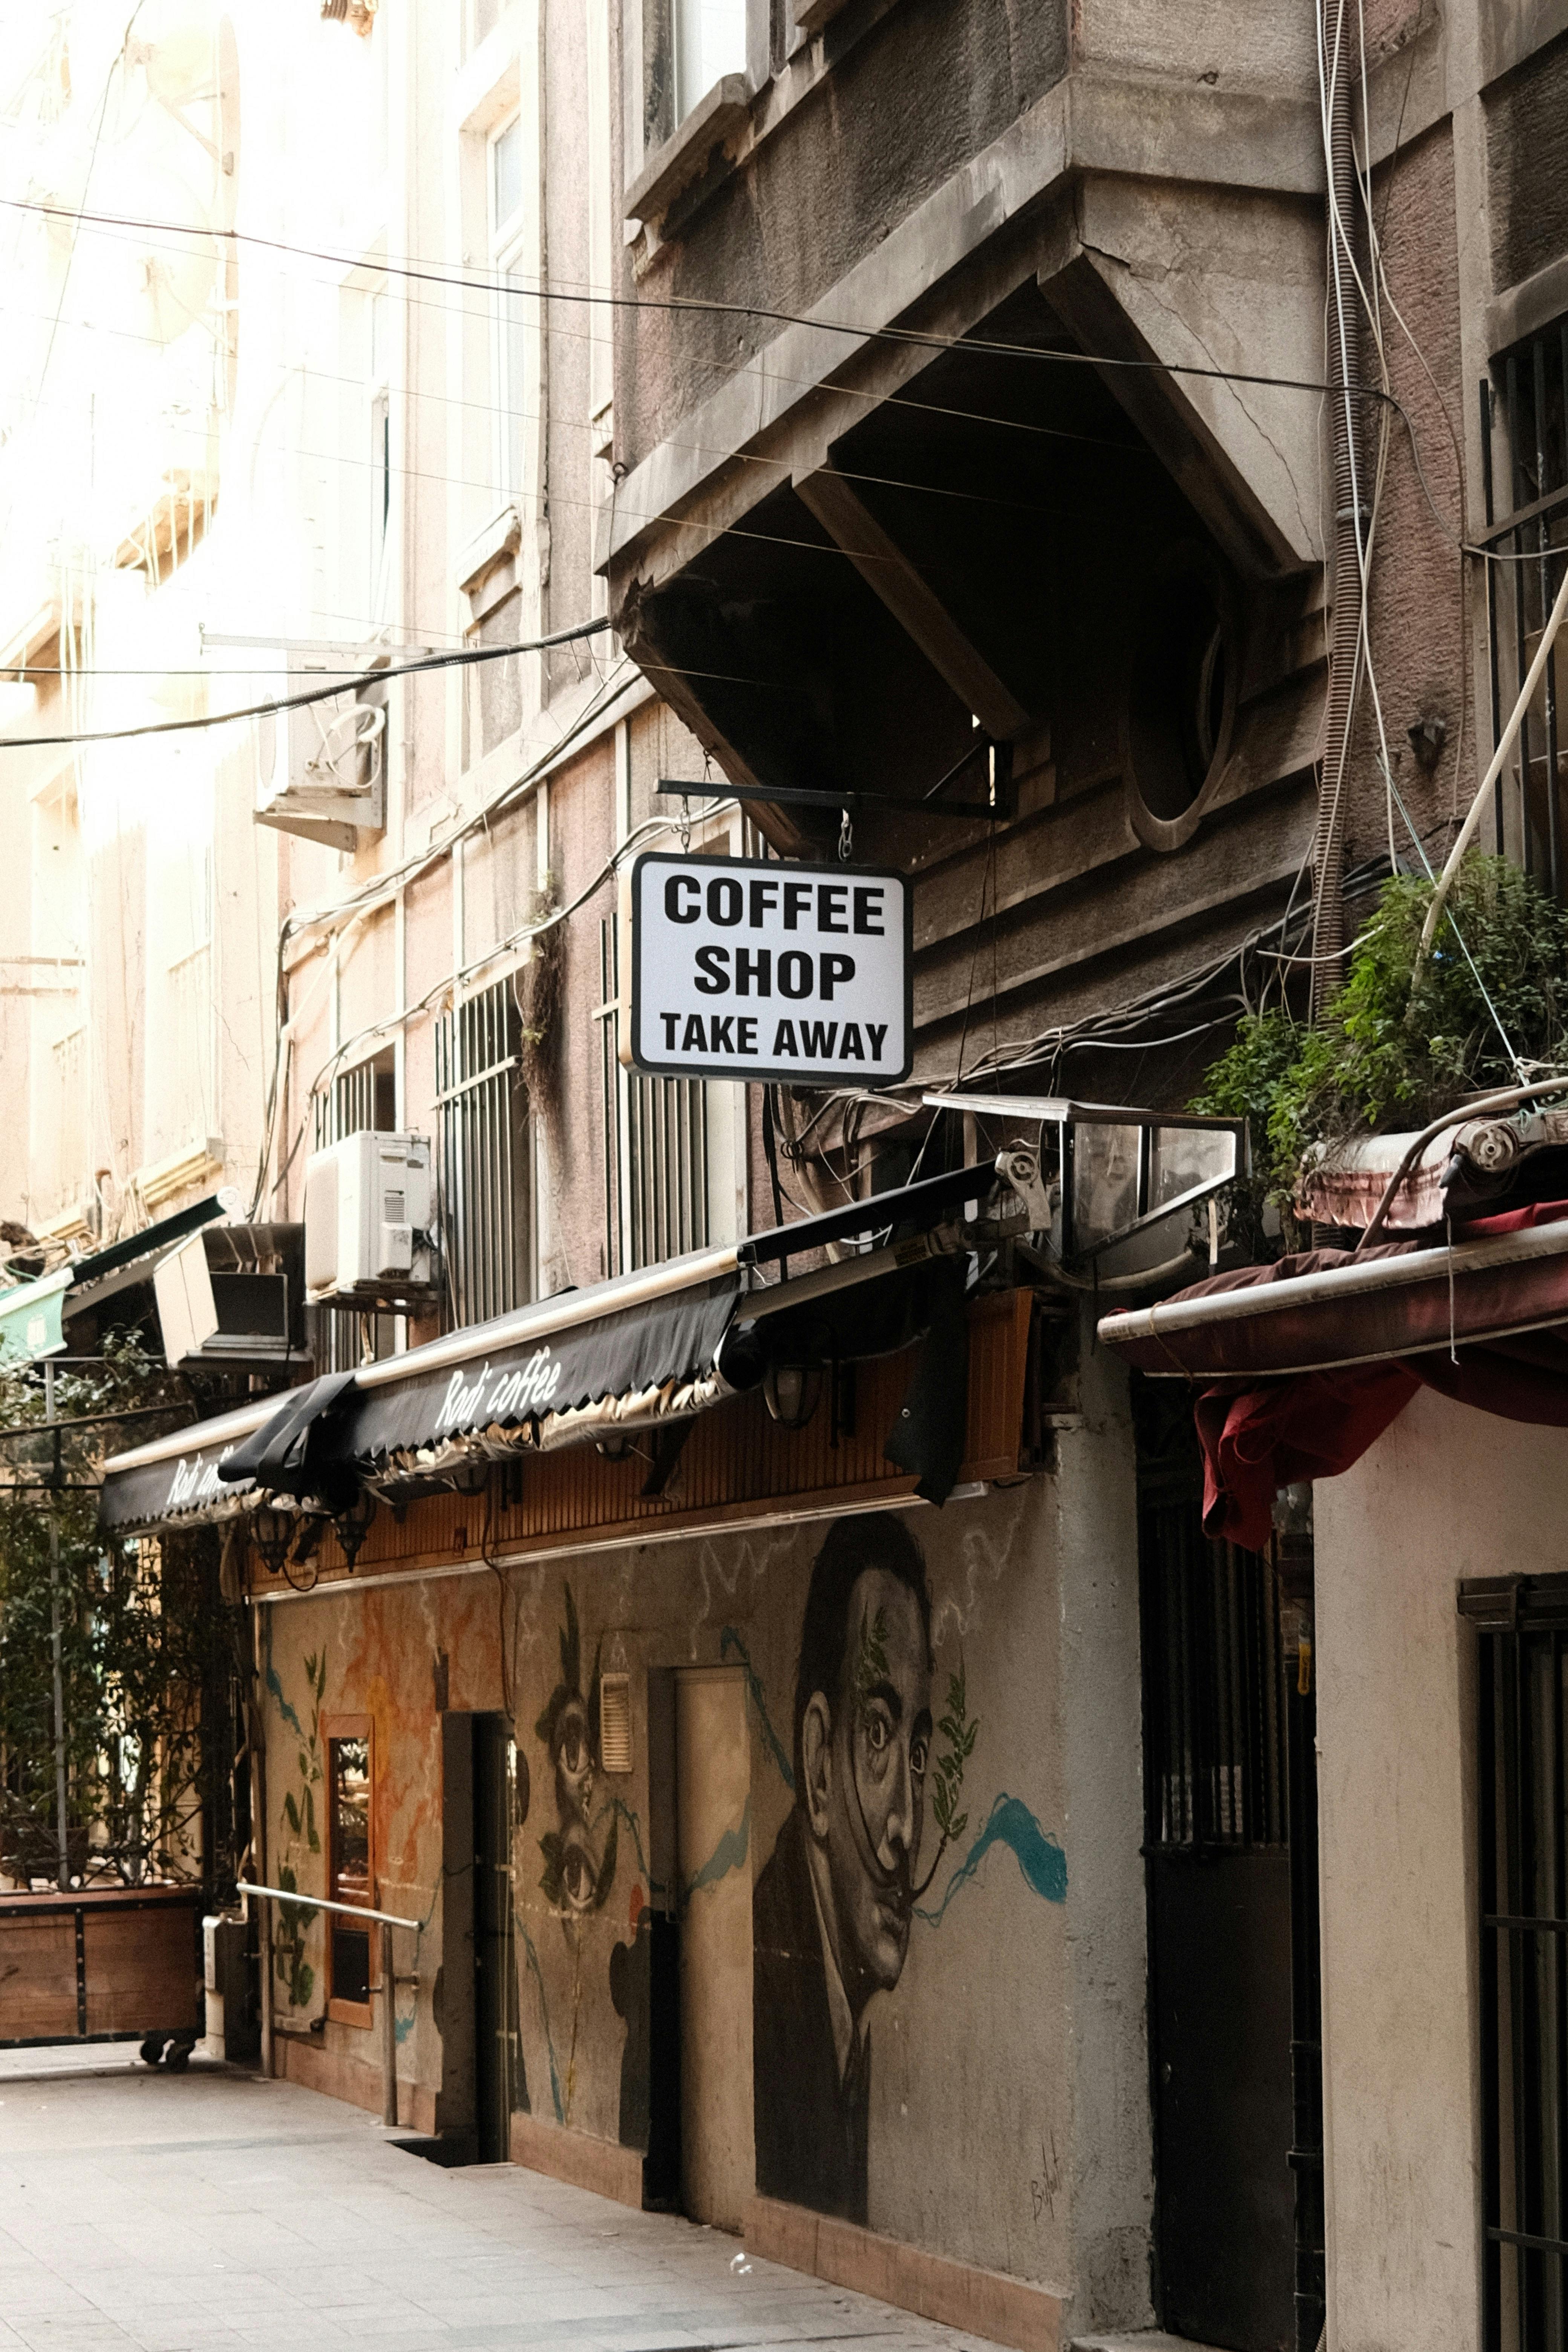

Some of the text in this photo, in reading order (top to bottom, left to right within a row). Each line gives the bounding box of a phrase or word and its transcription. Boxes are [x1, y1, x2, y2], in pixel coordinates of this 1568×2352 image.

[665, 875, 885, 936] COFFEE
[694, 945, 855, 1001] SHOP
[660, 1012, 888, 1061] TAKE AWAY
[486, 1346, 561, 1413] coffee
